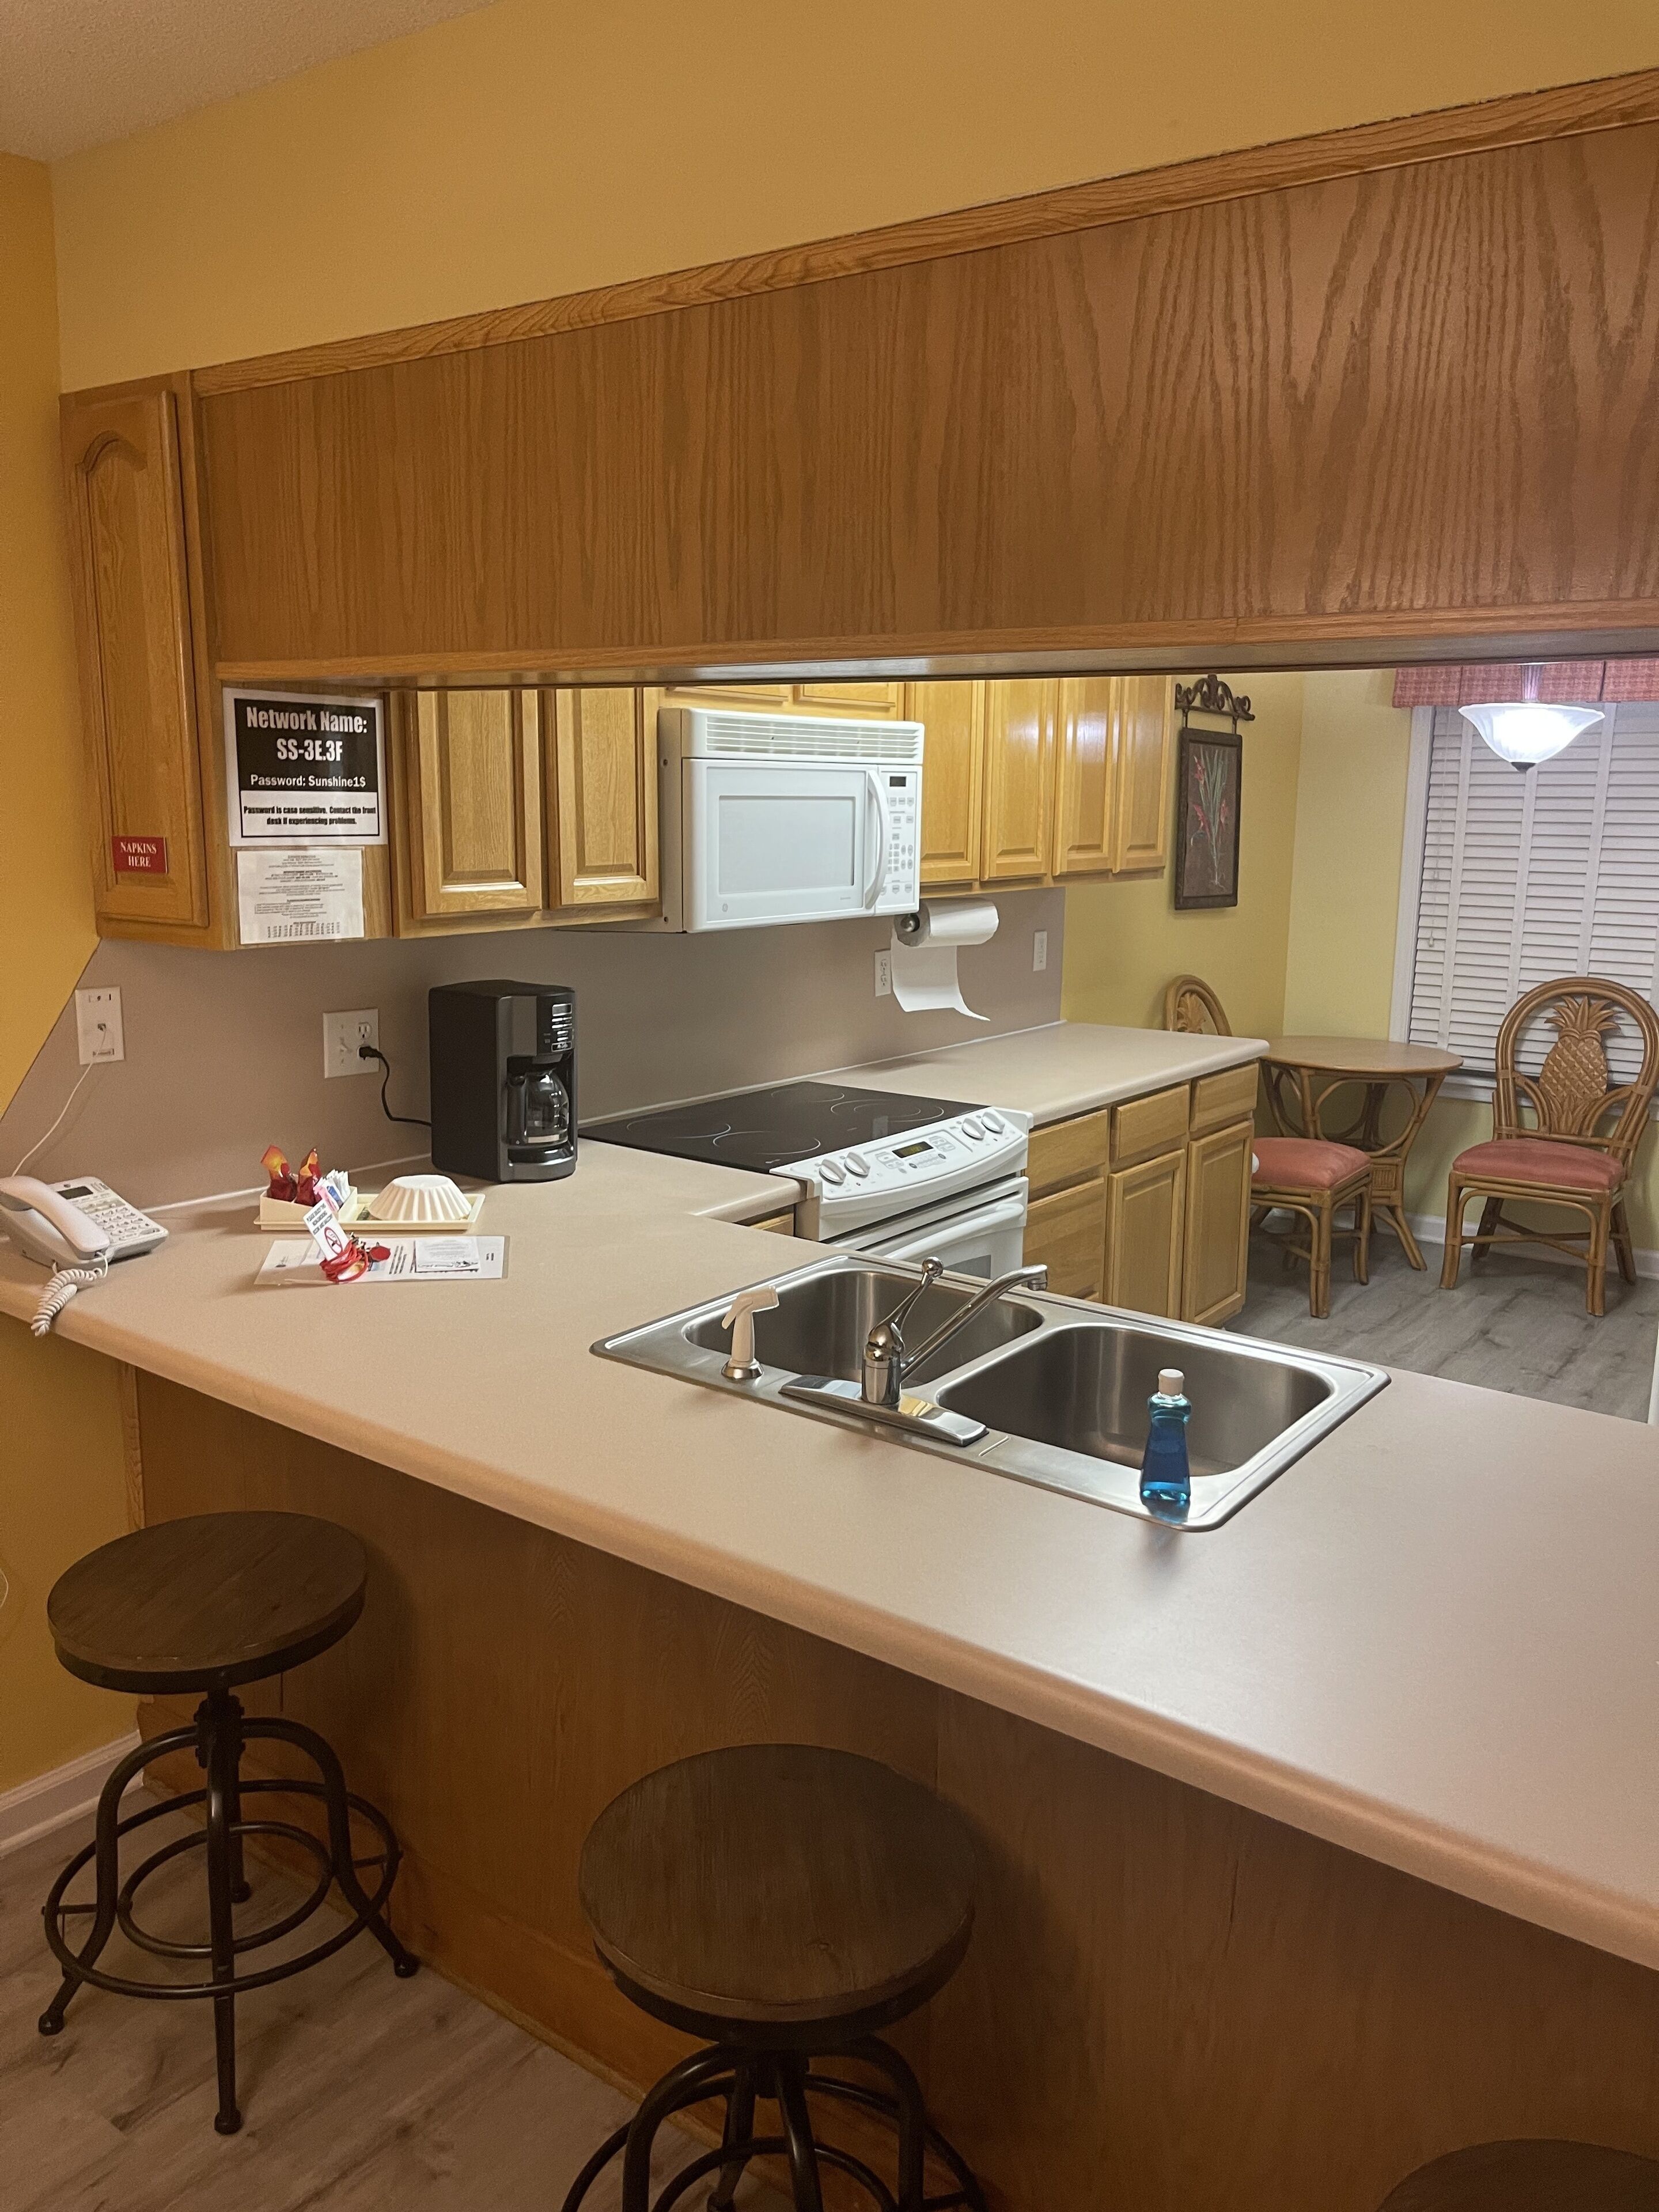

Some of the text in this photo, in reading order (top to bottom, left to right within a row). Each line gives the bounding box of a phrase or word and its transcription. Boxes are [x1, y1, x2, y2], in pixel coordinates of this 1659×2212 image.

[246, 706, 367, 733] Network Name:
[276, 738, 343, 762] SS-3E.3F
[250, 774, 306, 787] Password:
[244, 806, 275, 814] Password
[120, 842, 157, 854] NAPKINS
[128, 855, 151, 868] HERE
